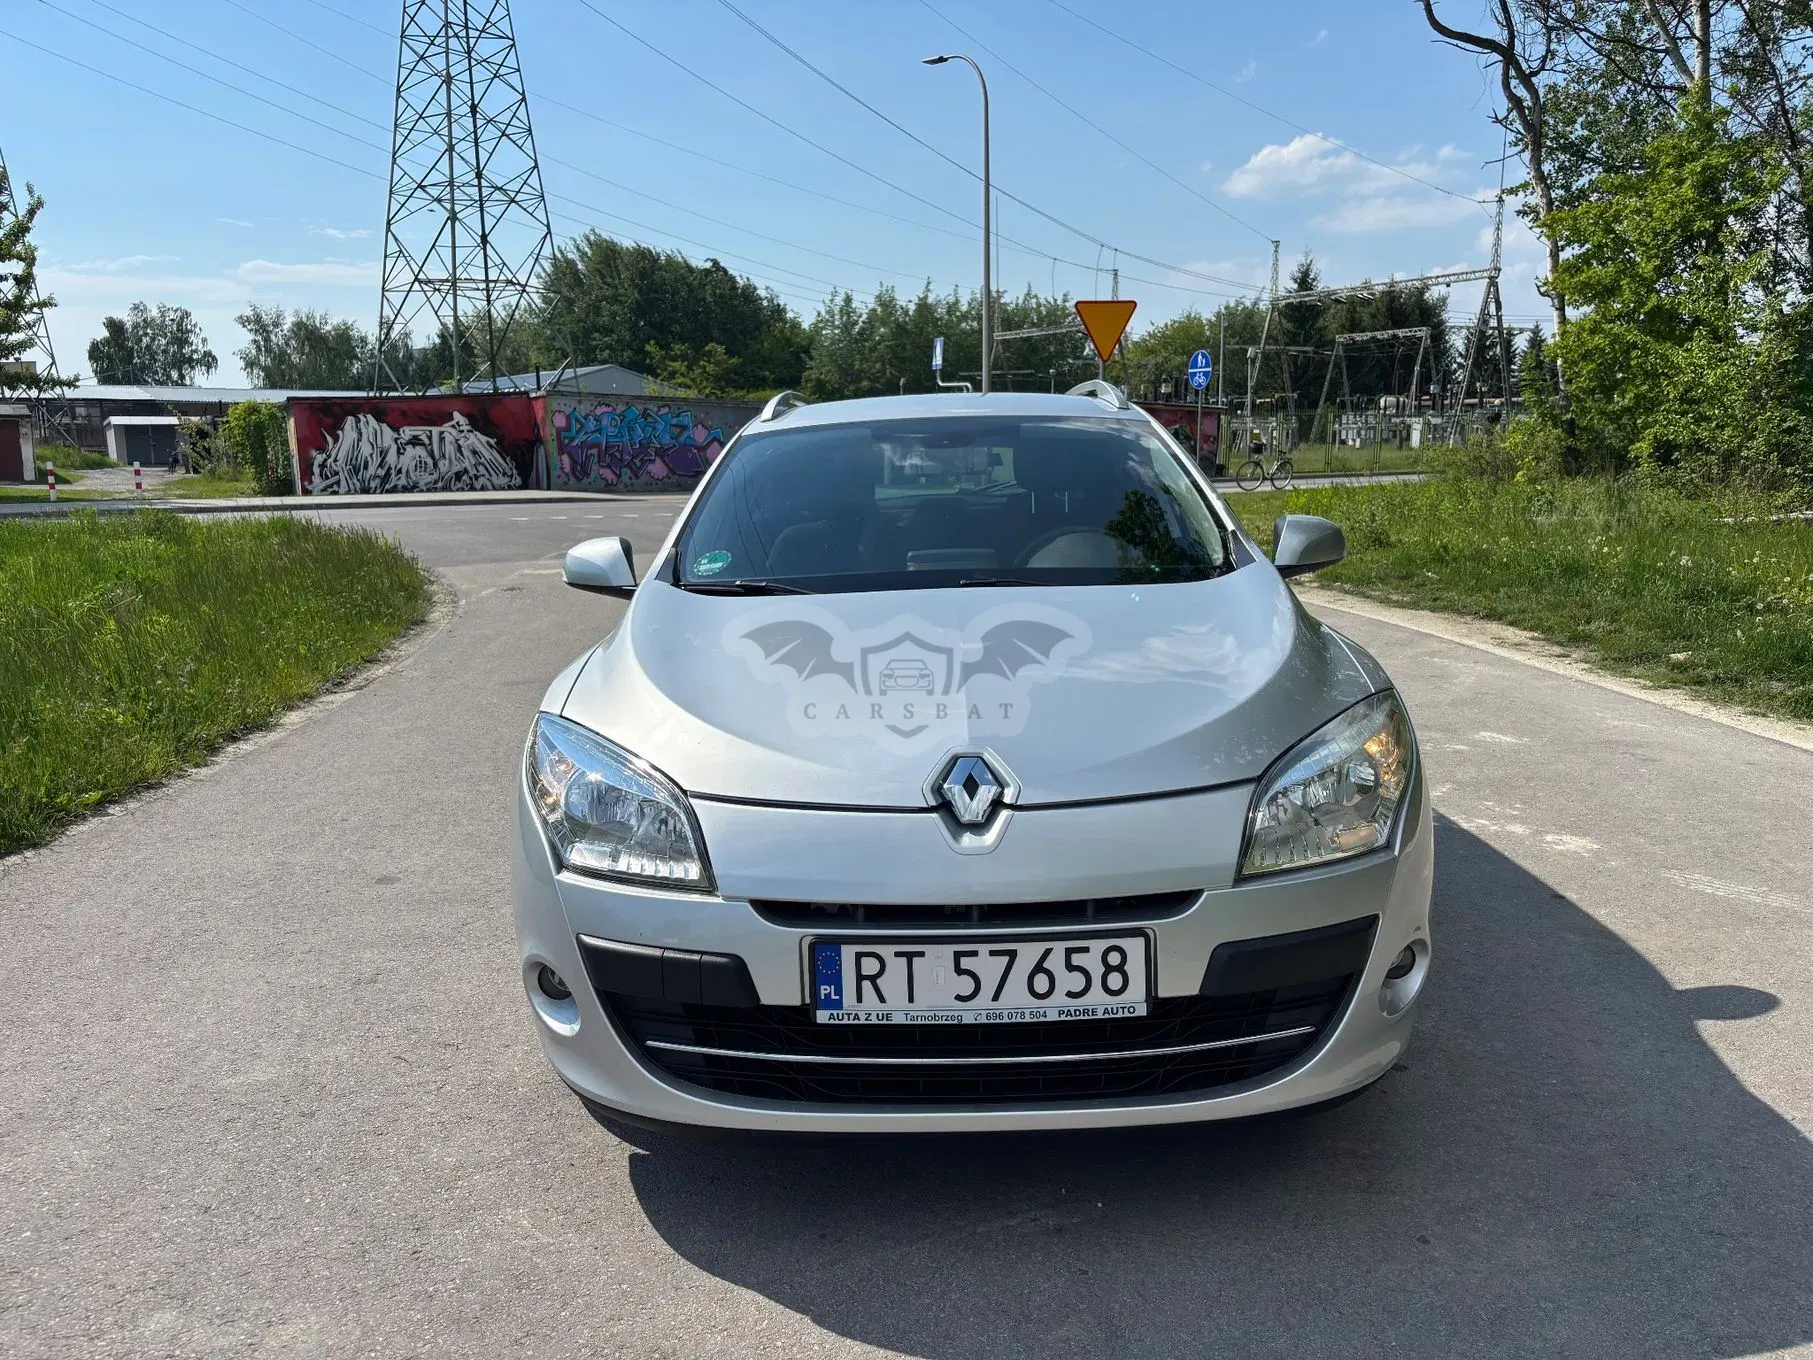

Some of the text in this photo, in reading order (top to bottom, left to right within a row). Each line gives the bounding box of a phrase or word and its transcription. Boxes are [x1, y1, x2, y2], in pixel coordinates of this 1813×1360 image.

[854, 944, 1130, 1004] RT 57658
[820, 985, 840, 999] PL
[828, 1005, 1136, 1024] AUTA Z UE Tarnobrzeg 696 078 504 PADRE AUTO
